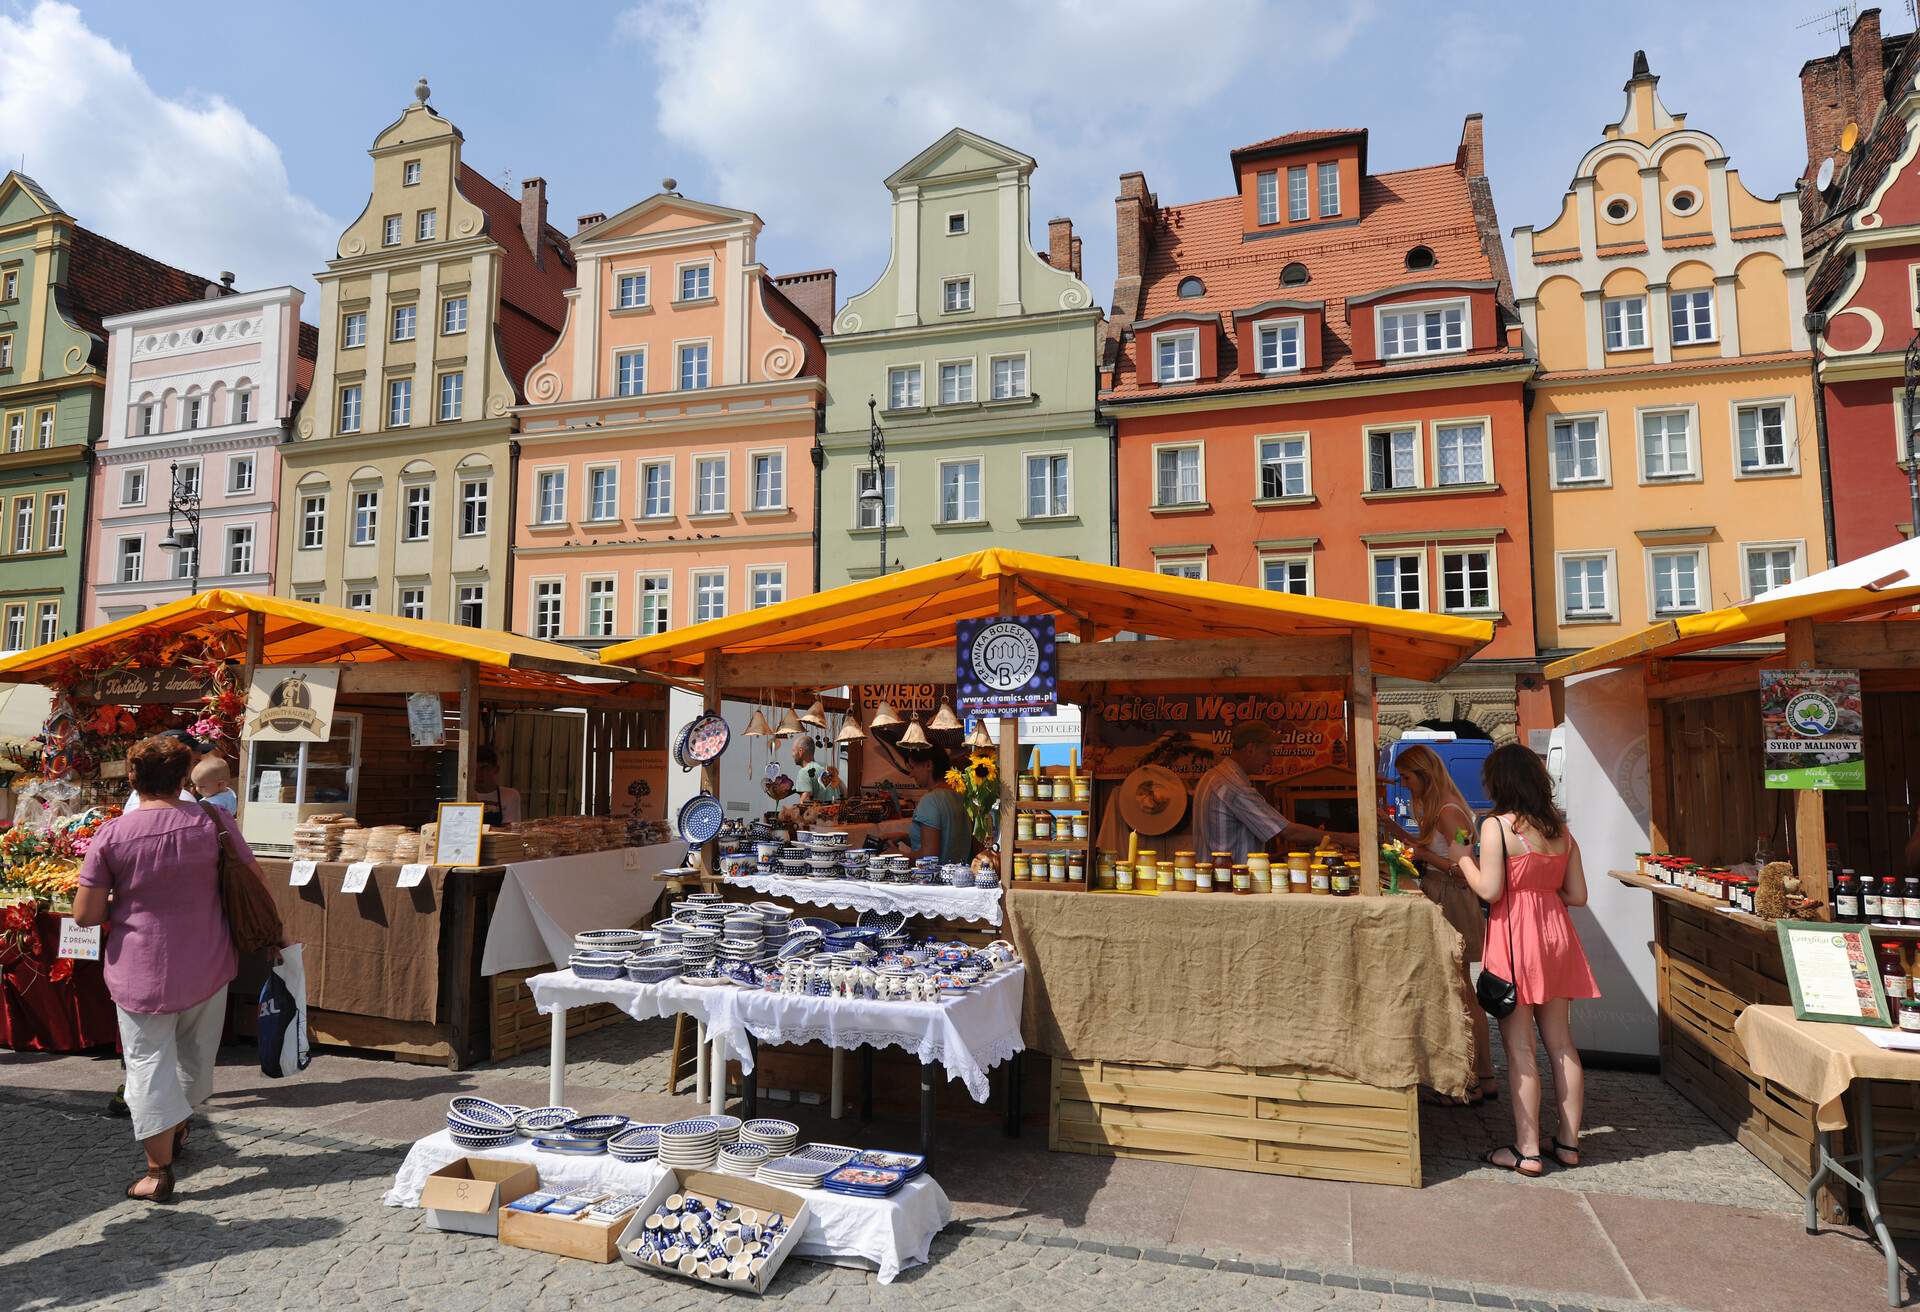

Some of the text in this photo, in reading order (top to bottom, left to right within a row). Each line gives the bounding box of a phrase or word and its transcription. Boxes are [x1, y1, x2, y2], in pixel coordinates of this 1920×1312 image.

[974, 624, 1036, 685] CERAMIKA BOLESŁAWIECKA
[999, 667, 1011, 686] B
[152, 681, 160, 692] z
[962, 692, 1053, 703] www.ceramics.com.pl
[1032, 725, 1080, 733] DENI CLER
[1272, 730, 1322, 744] aleta
[1770, 742, 1802, 750] SYROP
